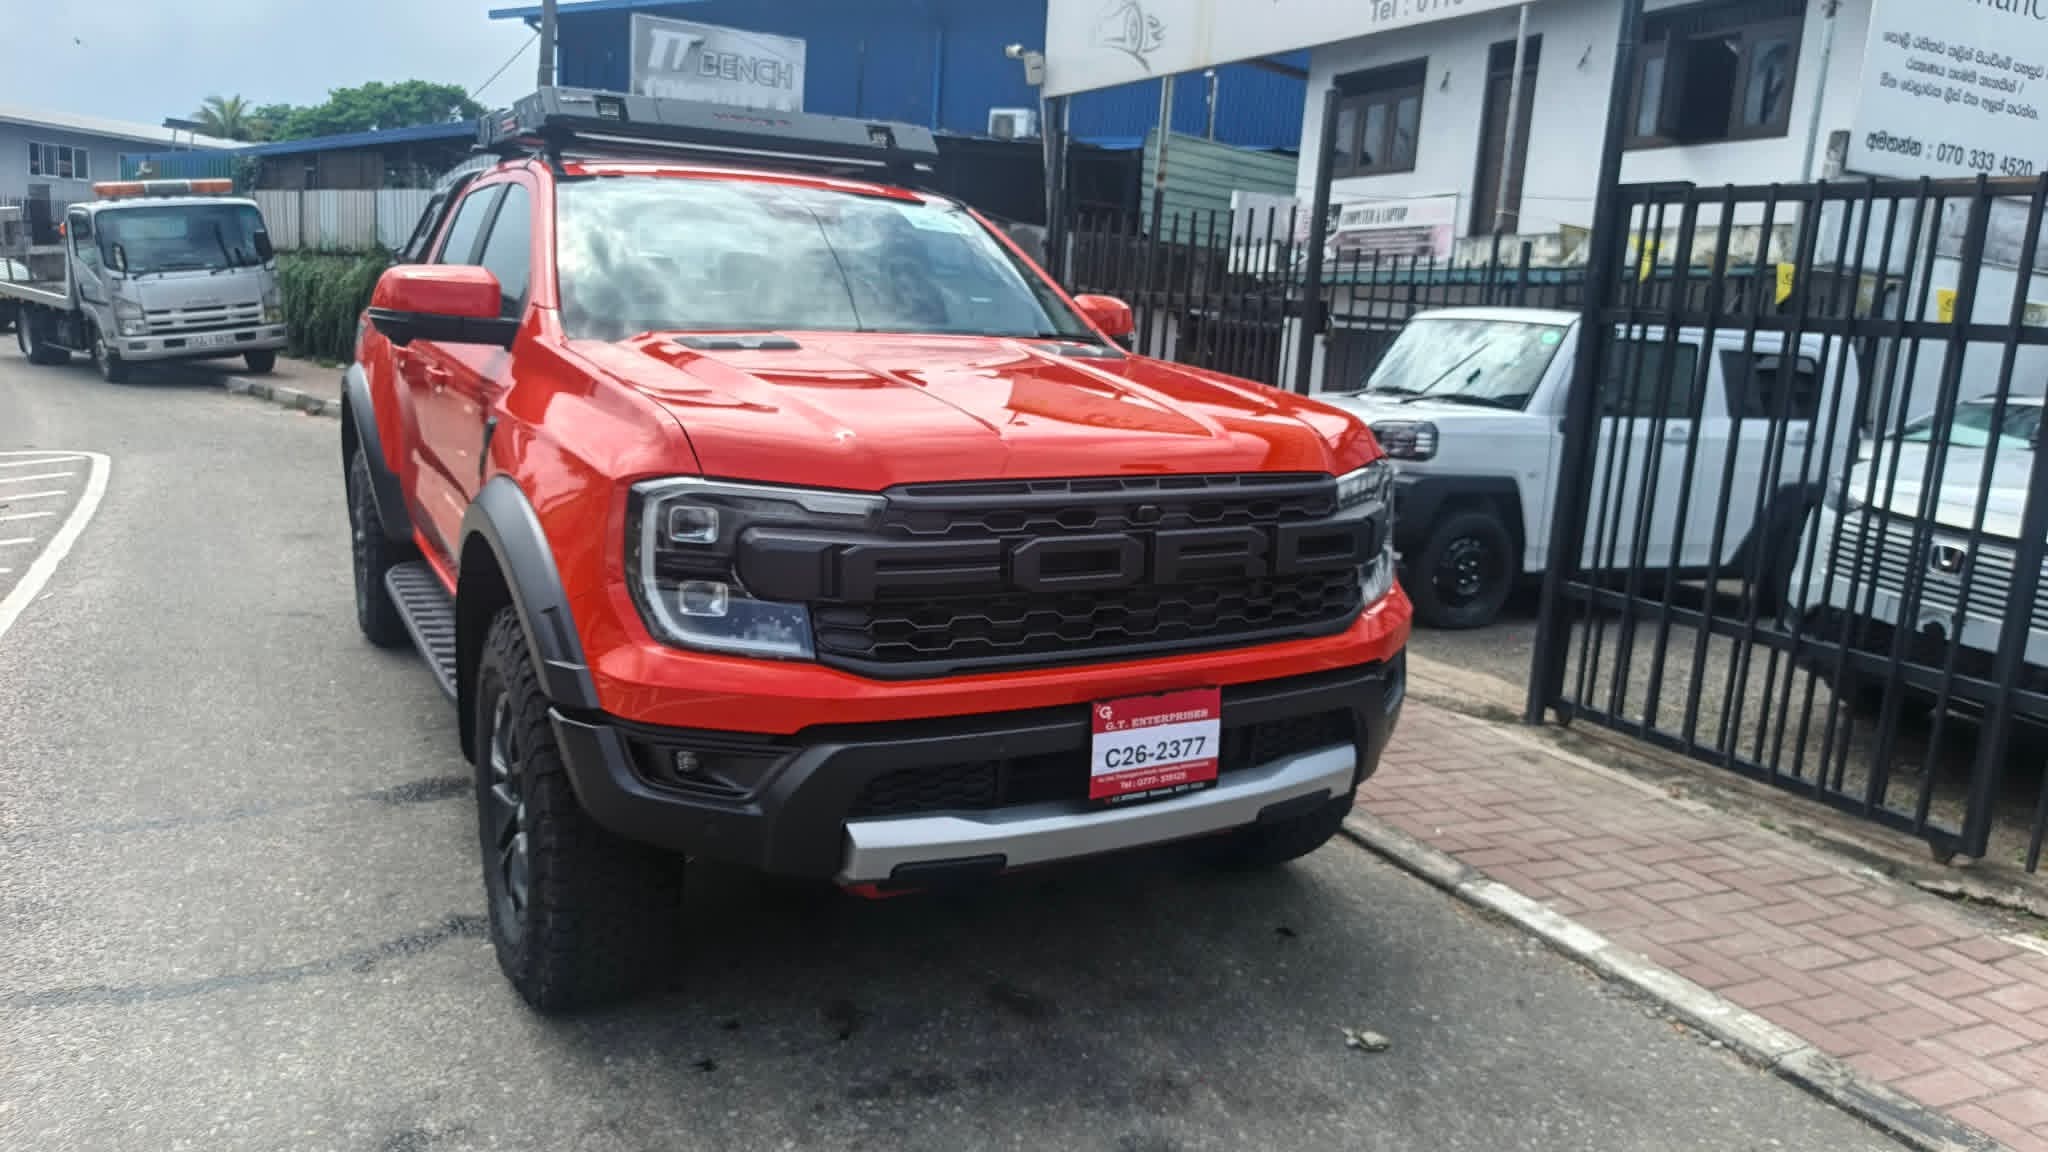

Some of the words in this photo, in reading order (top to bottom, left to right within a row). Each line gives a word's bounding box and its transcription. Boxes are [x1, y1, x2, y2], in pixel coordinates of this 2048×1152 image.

[1936, 143, 1965, 166] 070
[1968, 149, 1995, 172] 333
[1999, 154, 2033, 177] 4520
[840, 517, 1364, 600] FORD
[1105, 736, 1206, 768] C26-2377
